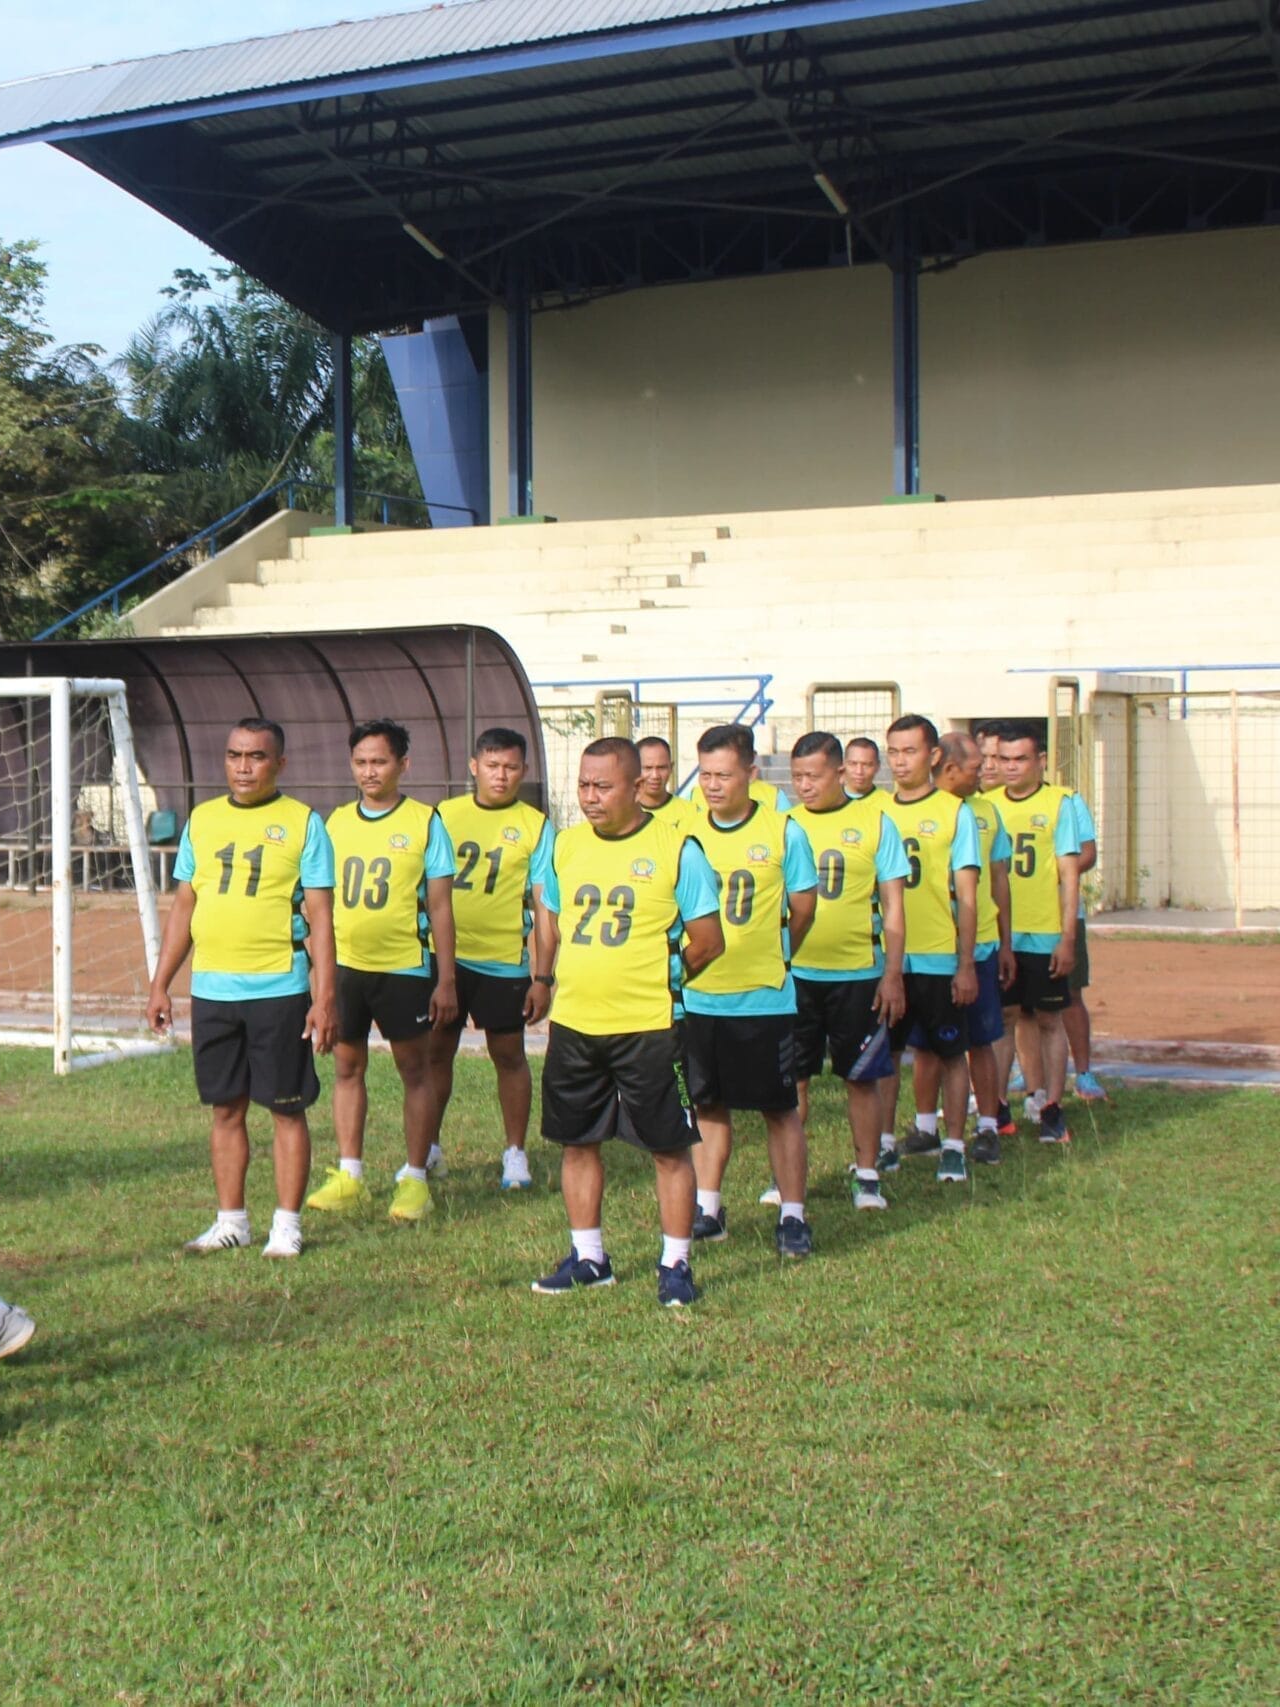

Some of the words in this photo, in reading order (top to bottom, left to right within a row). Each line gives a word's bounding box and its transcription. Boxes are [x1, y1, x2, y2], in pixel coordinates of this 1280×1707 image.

[214, 842, 265, 897] 11
[341, 856, 392, 910] 03
[452, 840, 503, 895] 21
[571, 884, 635, 947] 23
[713, 868, 755, 926] 0
